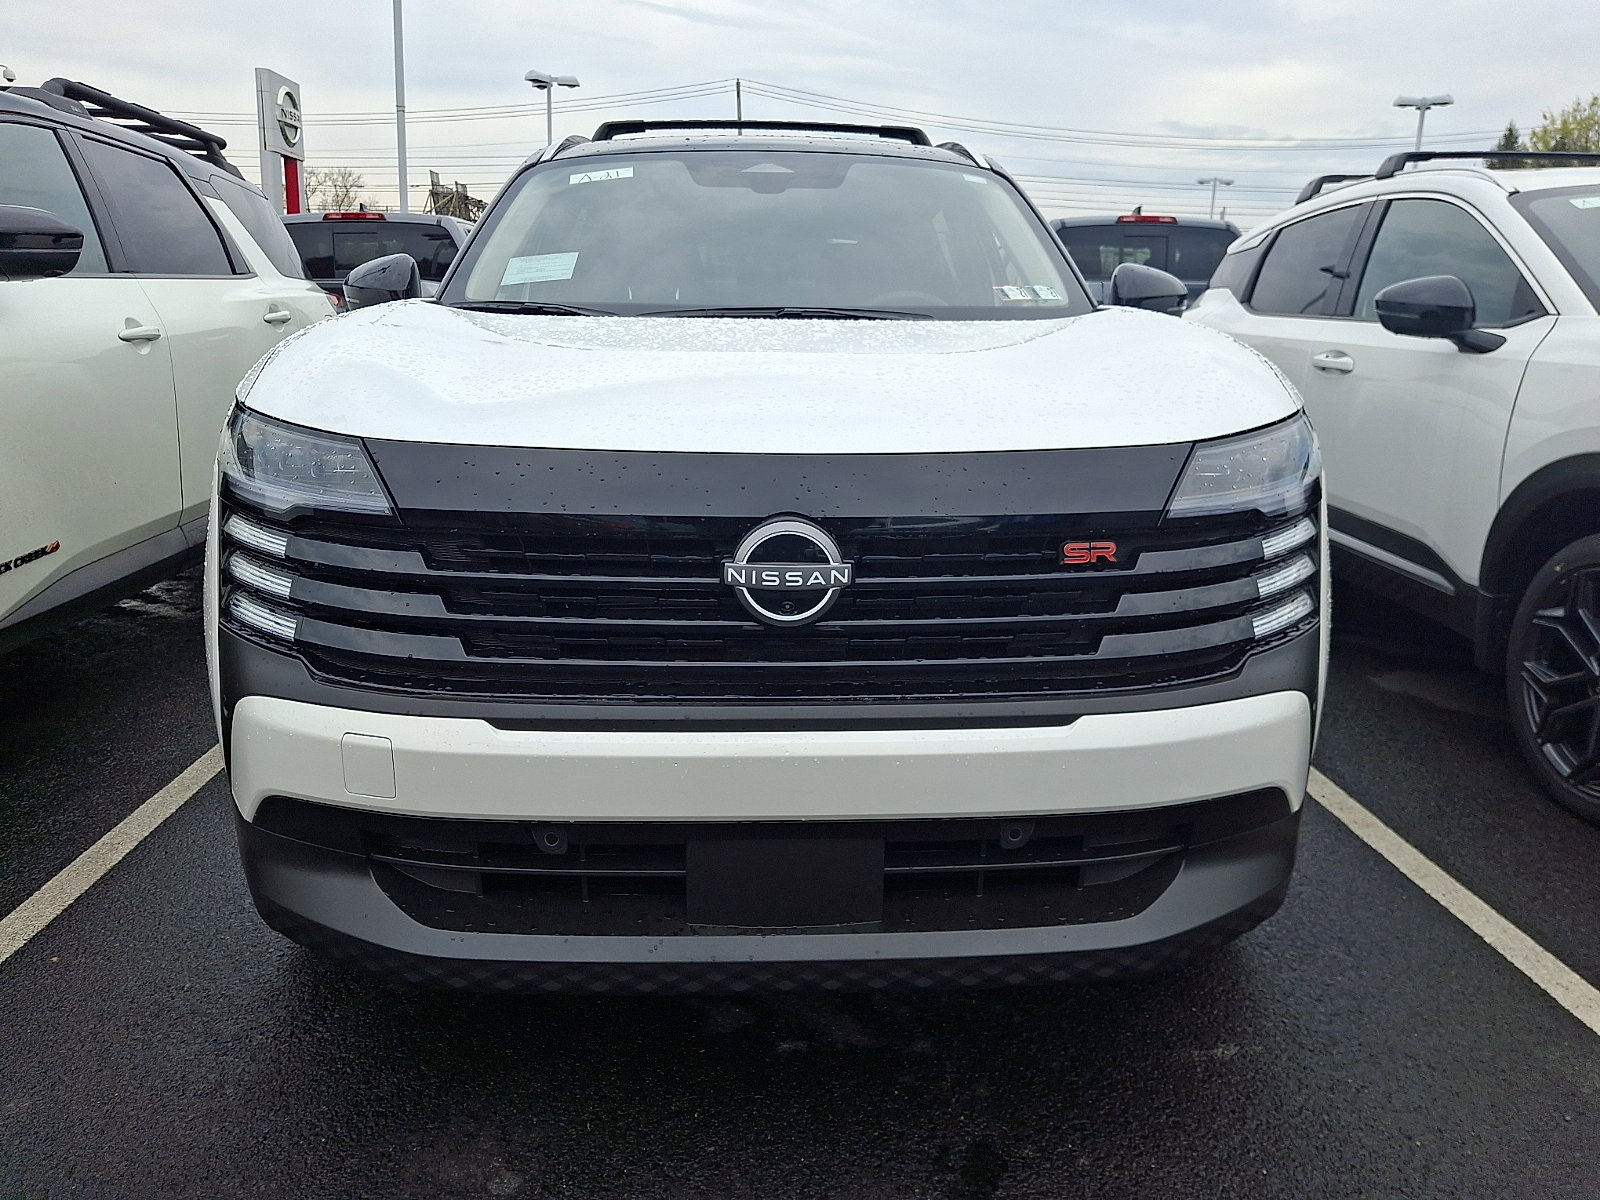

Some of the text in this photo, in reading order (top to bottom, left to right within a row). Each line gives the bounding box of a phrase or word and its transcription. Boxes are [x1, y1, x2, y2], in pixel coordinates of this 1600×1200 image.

[13, 544, 49, 569] CREEK
[1063, 541, 1117, 564] SR
[727, 567, 849, 586] NISSAN
